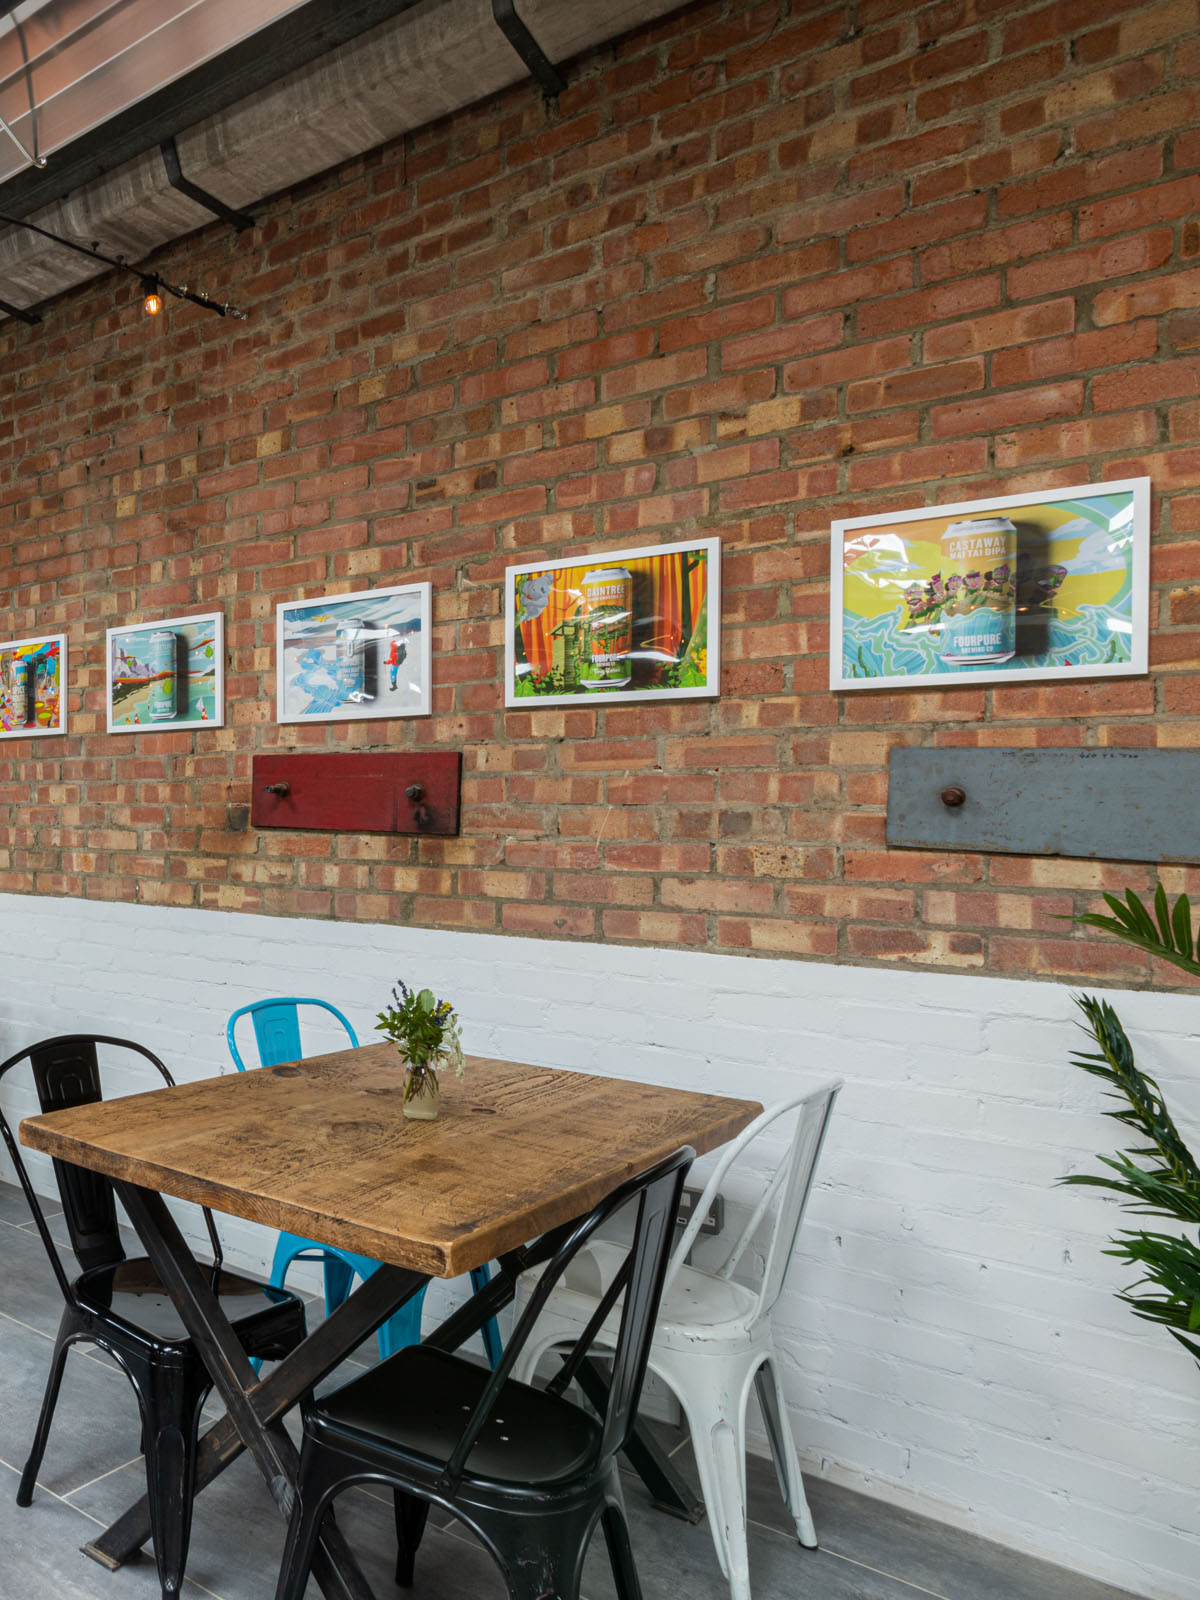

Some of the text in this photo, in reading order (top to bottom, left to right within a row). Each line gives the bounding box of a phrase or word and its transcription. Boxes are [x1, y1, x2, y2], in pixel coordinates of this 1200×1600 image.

[949, 536, 1006, 552] CASTAWAY
[967, 549, 983, 558] TAI
[587, 584, 625, 597] DAINTREE
[953, 633, 1001, 648] FOURPURE
